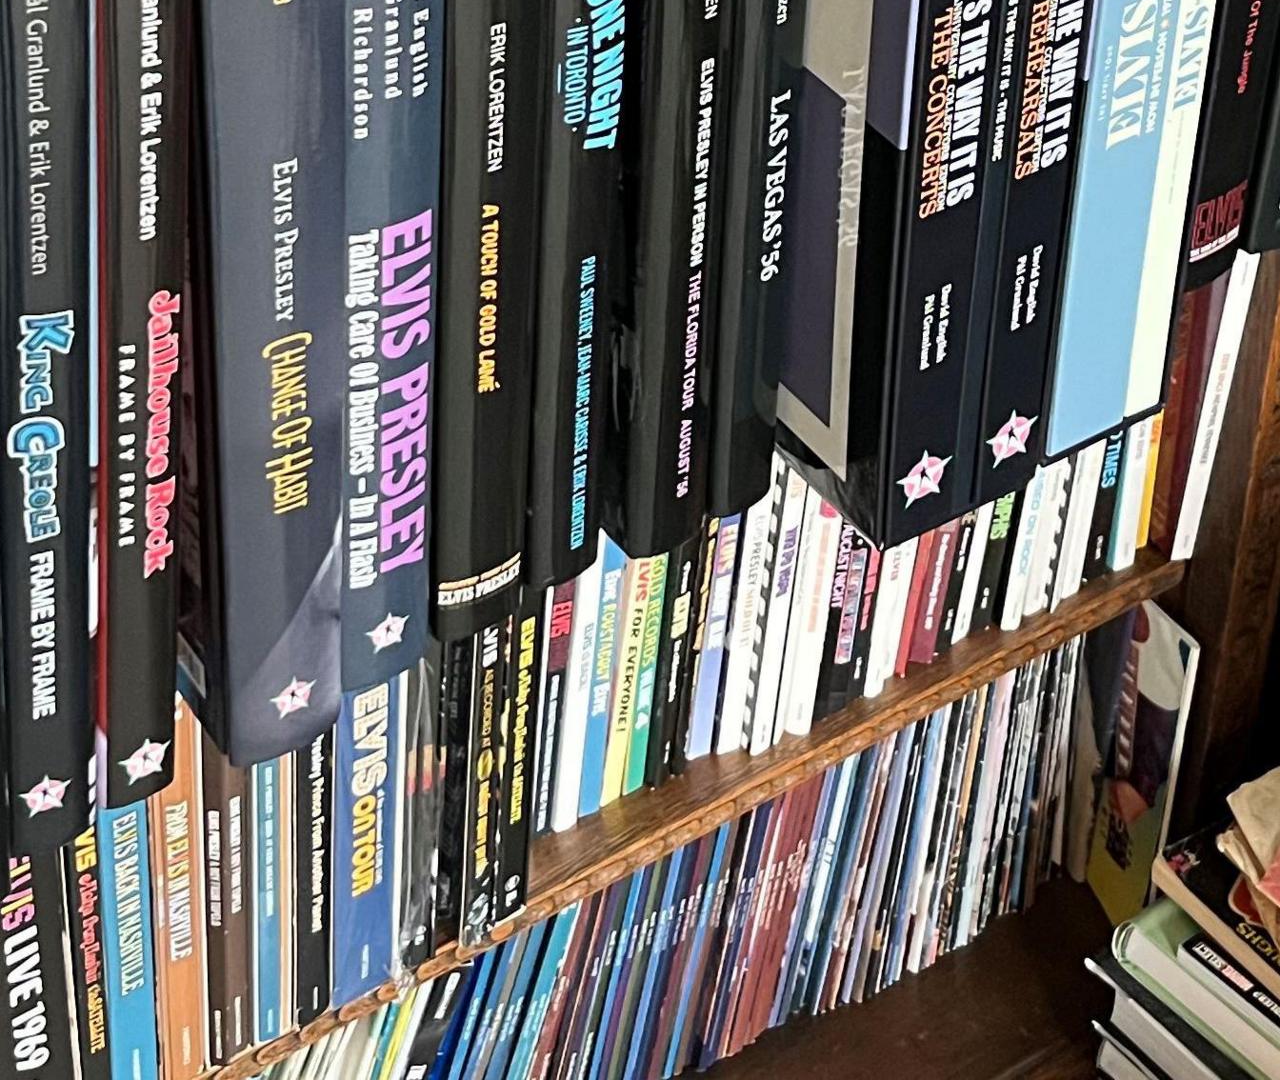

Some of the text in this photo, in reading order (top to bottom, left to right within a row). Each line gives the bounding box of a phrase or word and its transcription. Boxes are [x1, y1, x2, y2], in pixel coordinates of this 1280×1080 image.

[1244, 17, 1260, 50] The
[1250, 0, 1262, 17] Of
[24, 18, 49, 114] Granlund
[140, 71, 163, 90] &
[353, 8, 374, 140] Richardson
[409, 8, 431, 98] English
[564, 26, 589, 124] IN TORONTO
[958, 19, 990, 80] THE
[1048, 37, 1080, 102] WAY
[1152, 31, 1168, 87] PERSON
[1173, 5, 1209, 110] ELVIS
[1236, 49, 1254, 95] Jungle
[28, 118, 49, 138] &
[139, 90, 163, 136] Erik
[487, 22, 507, 173] ERIK LORENTZEN
[583, 41, 624, 151] NIGHT
[919, 6, 953, 219] THE CONCERTS
[952, 75, 985, 141] WAY
[1044, 102, 1072, 134] IT
[1145, 101, 1159, 134] NOW
[1150, 86, 1160, 101] IN
[28, 140, 52, 179] Erik
[949, 141, 978, 172] IT
[1040, 133, 1069, 169] IS
[139, 137, 163, 242] Lorentzen
[946, 172, 975, 207] IS
[1192, 178, 1248, 250] ELVIS
[29, 180, 52, 277] Lorentzen
[261, 158, 313, 515] ELVIS PRESLEY CHANGE OF HABIT
[345, 228, 380, 590] Taking Care Of Business In A Flash
[380, 208, 433, 575] ELVIS PRESLEY
[118, 344, 136, 547] FRAME BY FRAME
[144, 289, 181, 578] Jailhouse Rock
[1101, 440, 1123, 489] TIMES
[550, 600, 573, 639] ELVIS
[831, 571, 847, 608] NIGHT
[352, 682, 388, 797] ELVIS
[351, 795, 377, 897] ON TOUR
[112, 811, 145, 996] ELVIS BACK IN NASHVILLE
[165, 800, 192, 962] FROM ELVIS IN NASHVILLE
